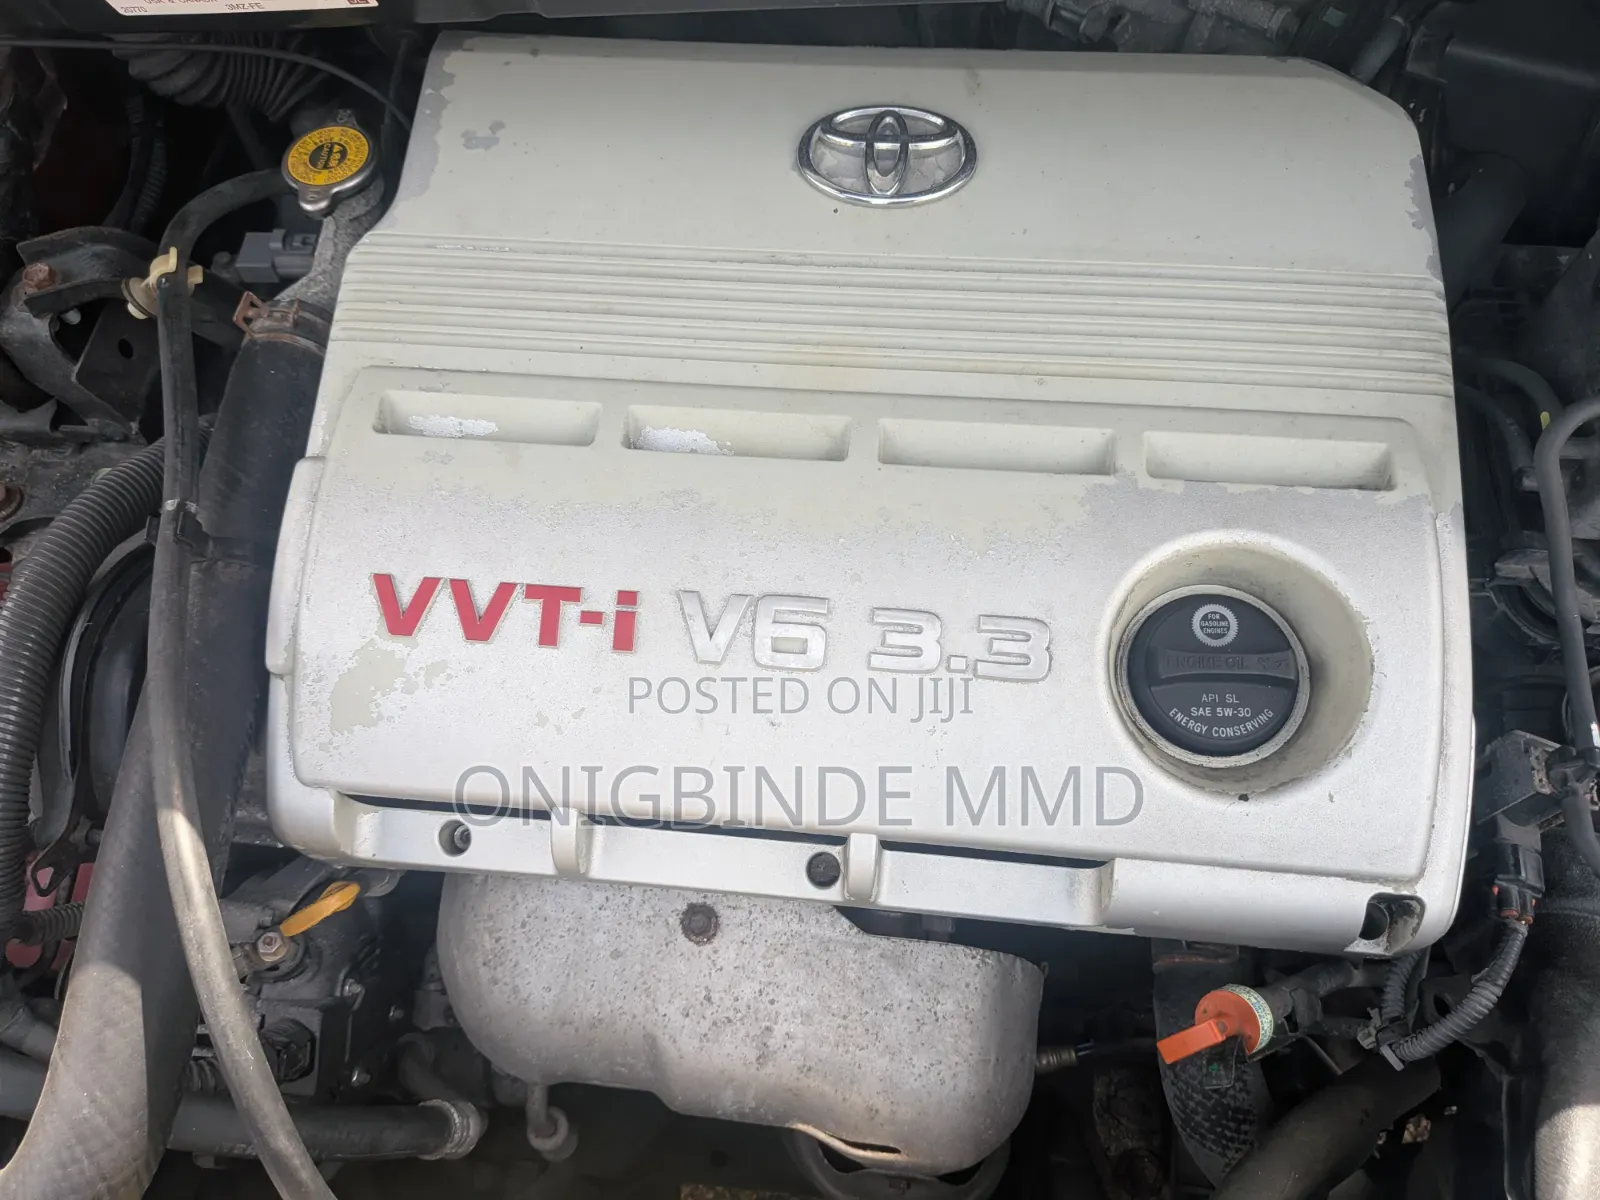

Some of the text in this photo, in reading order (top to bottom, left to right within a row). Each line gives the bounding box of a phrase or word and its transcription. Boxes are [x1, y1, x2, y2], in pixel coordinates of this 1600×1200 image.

[225, 2, 266, 11] 3MZ-FE
[371, 572, 1053, 683] VVT-i V6 3.3
[1201, 693, 1240, 703] API SL
[1190, 706, 1252, 717] SAE 5W-30
[1168, 707, 1275, 738] ENERGY CONSERVING
